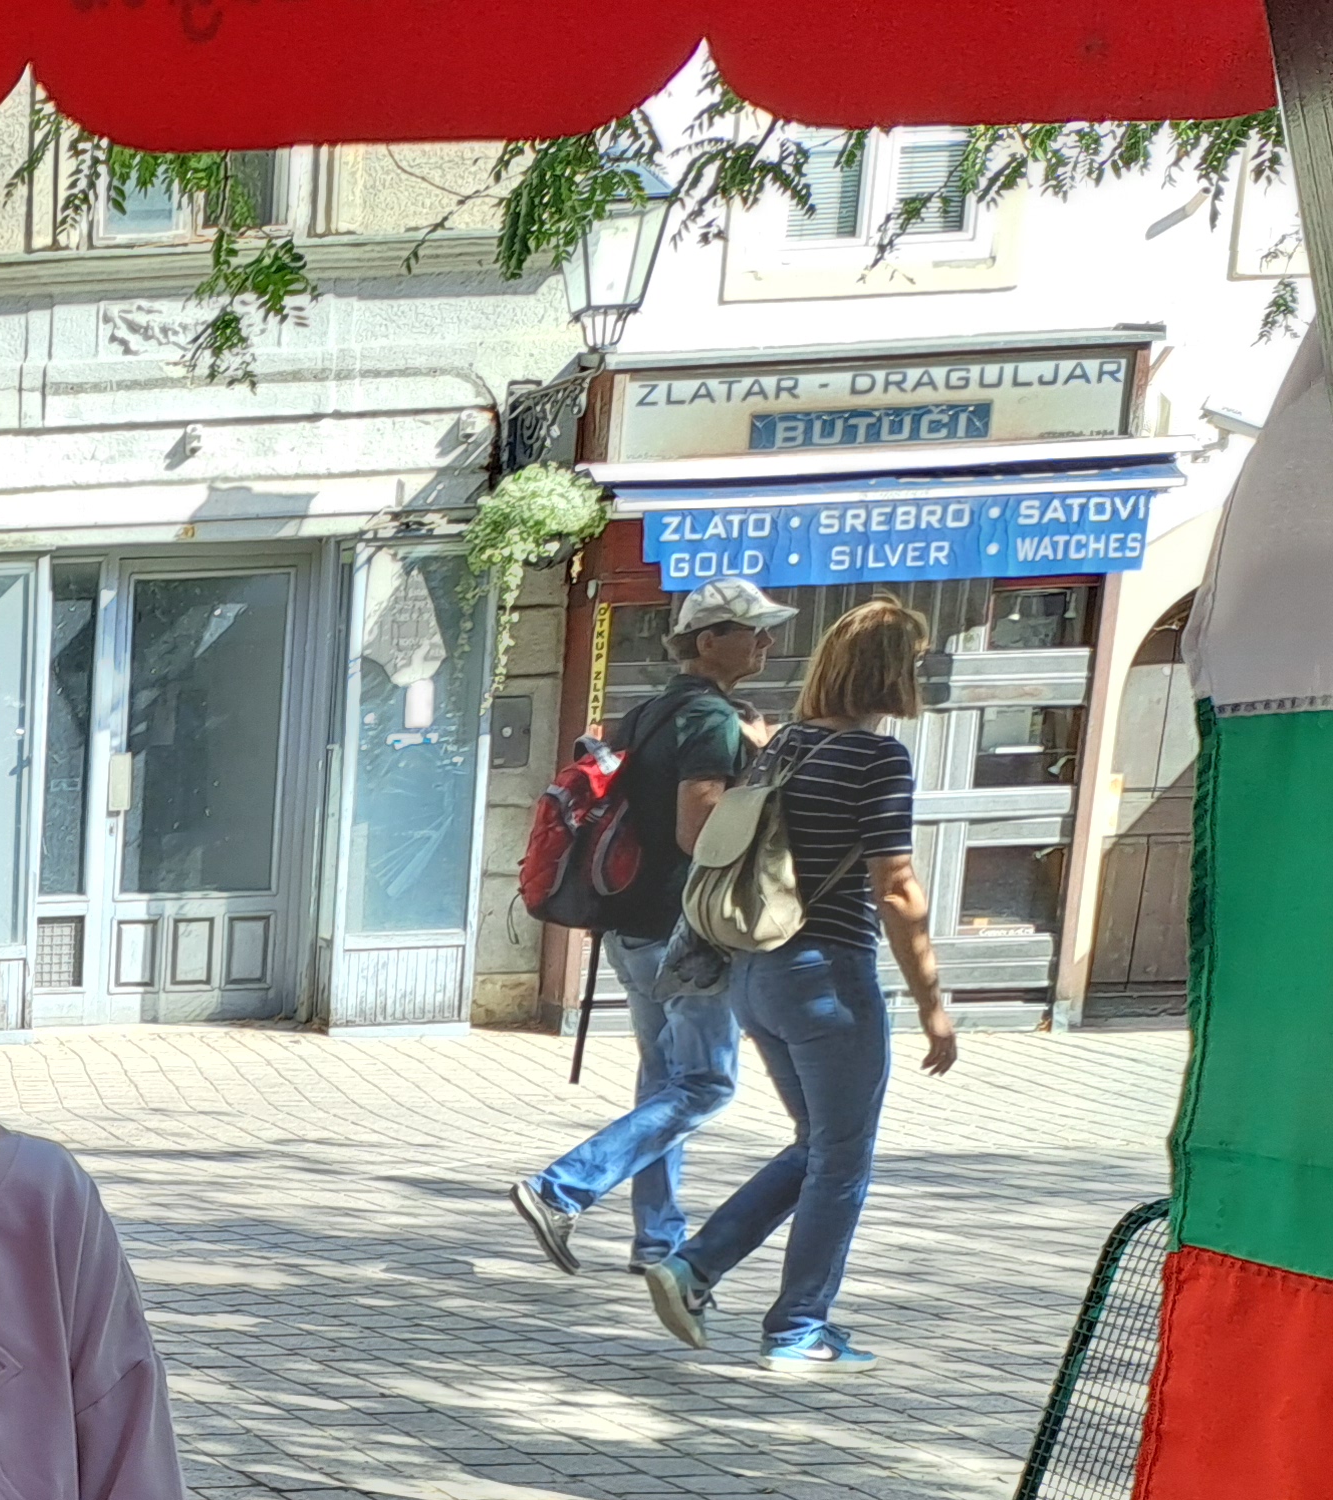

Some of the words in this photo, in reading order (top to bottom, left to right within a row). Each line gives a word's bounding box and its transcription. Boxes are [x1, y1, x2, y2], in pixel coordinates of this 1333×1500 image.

[636, 376, 800, 407] ZLATAR
[849, 360, 1123, 396] DRAGULJAR
[658, 513, 772, 542] ZLATO
[818, 503, 971, 535] SREBRO
[1017, 495, 1146, 526] SATOVI
[669, 550, 765, 578] GOLD
[829, 541, 950, 571] SILVER
[1016, 533, 1143, 563] WATCHES
[594, 606, 608, 662] OTKUP
